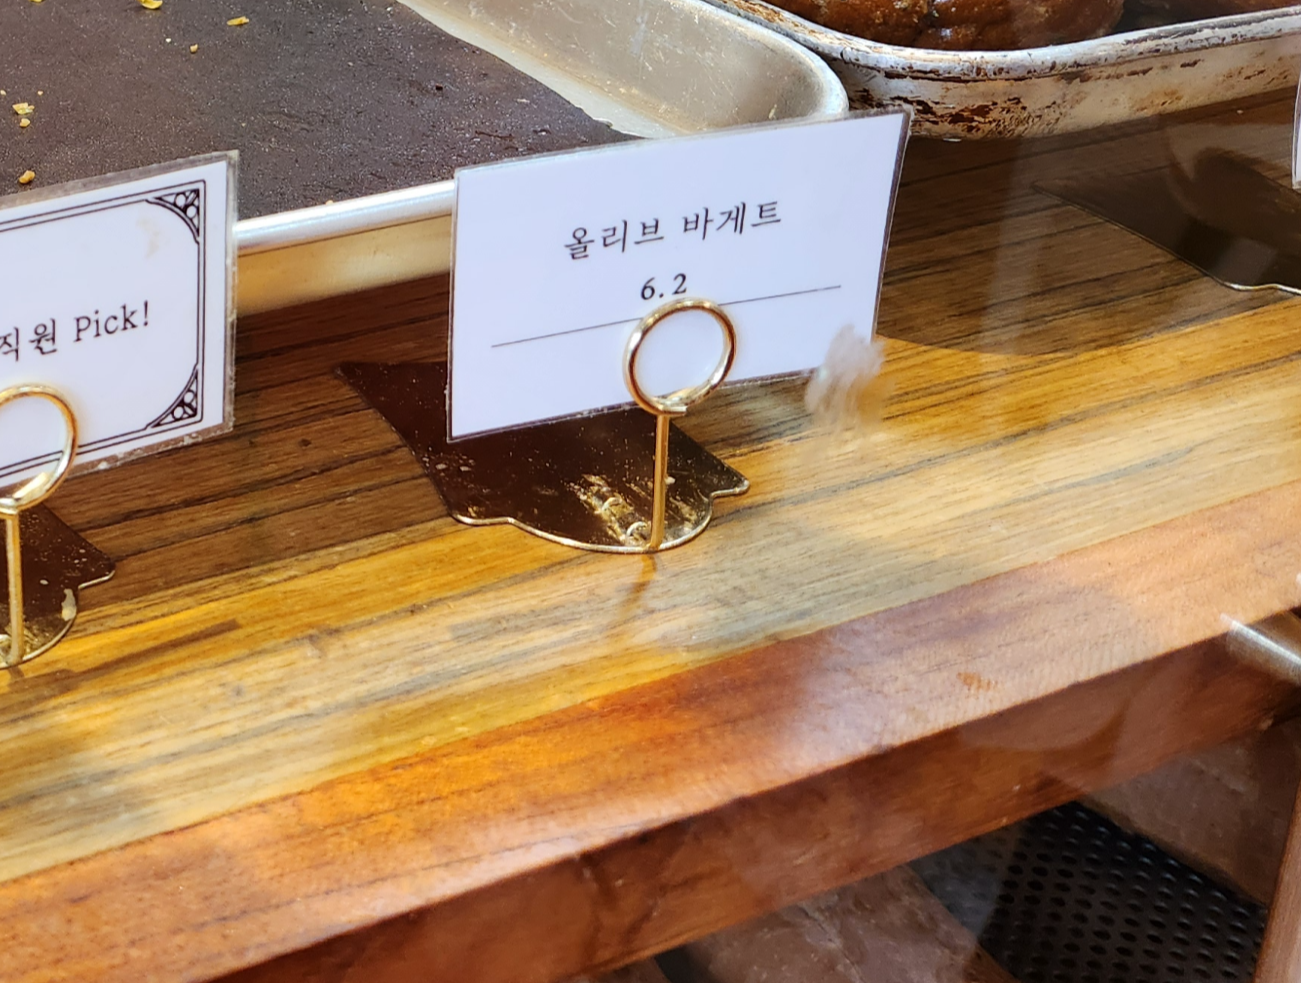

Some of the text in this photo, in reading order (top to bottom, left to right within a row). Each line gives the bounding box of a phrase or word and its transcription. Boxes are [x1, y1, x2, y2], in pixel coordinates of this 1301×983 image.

[563, 200, 782, 261] 올리브 바게트
[639, 272, 688, 301] 6.2
[72, 299, 150, 343] Pick!
